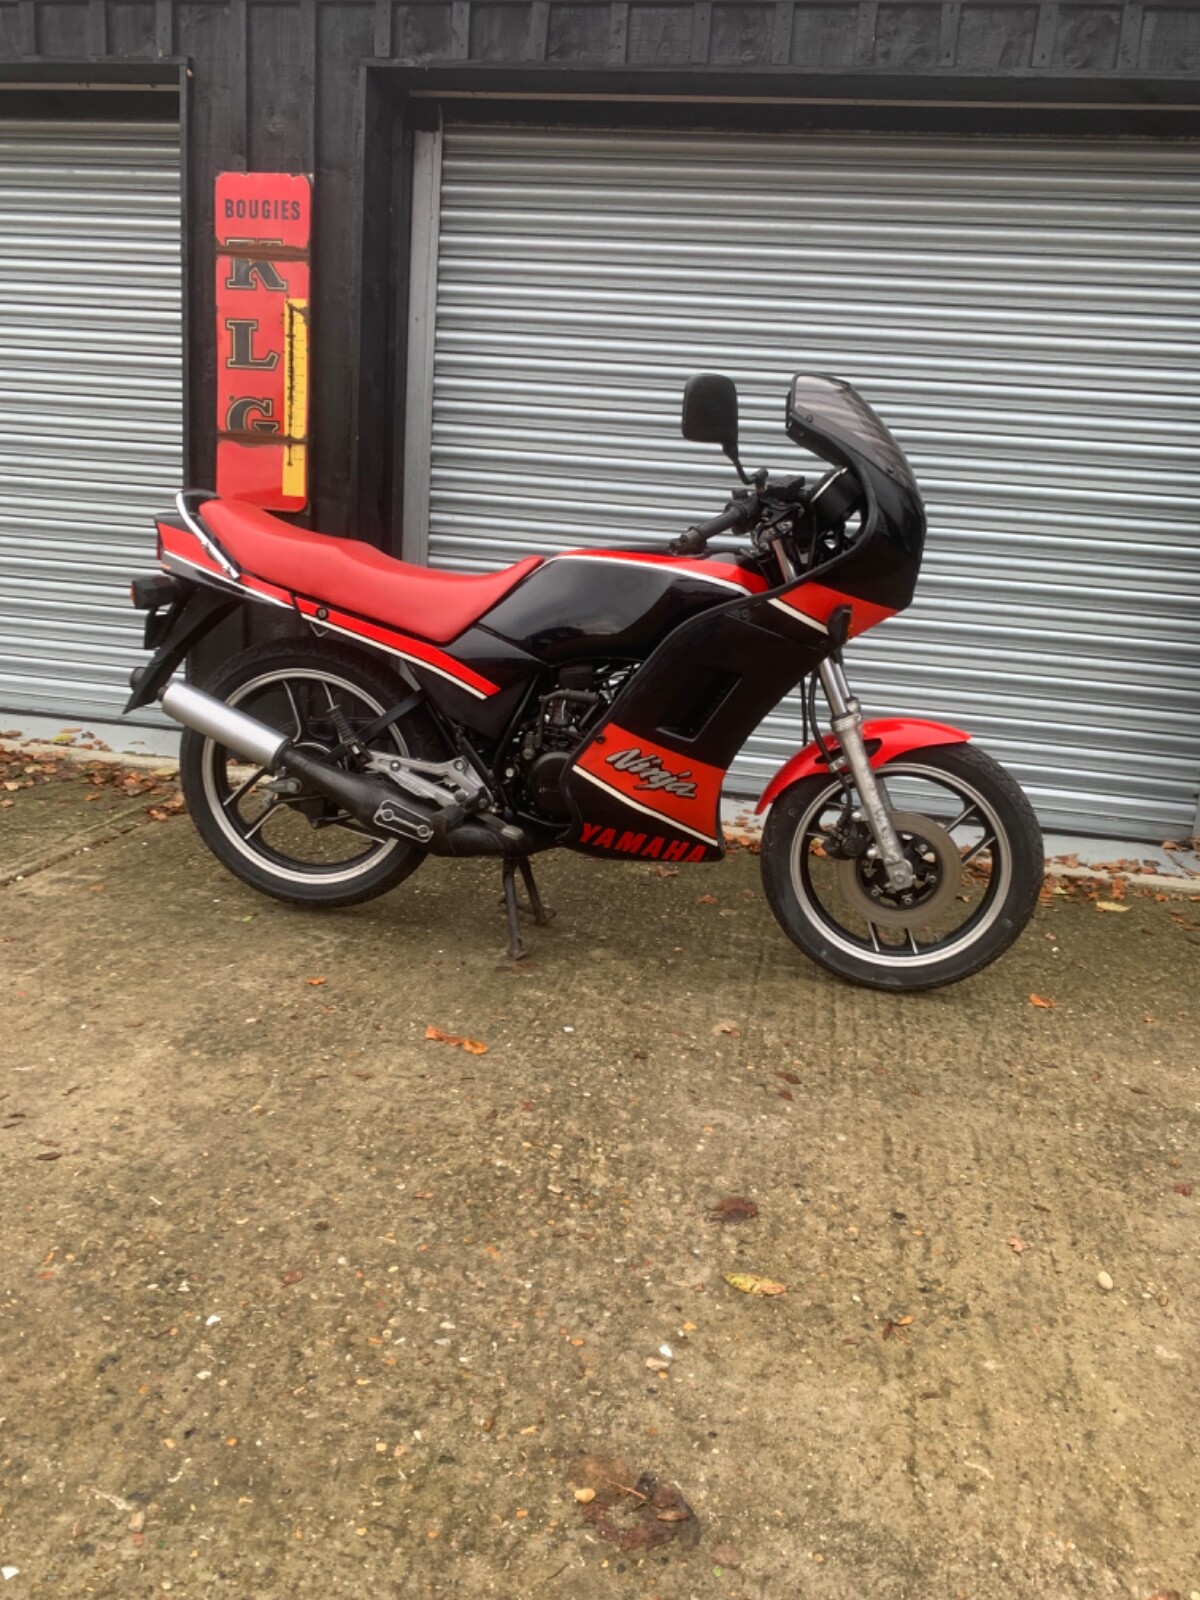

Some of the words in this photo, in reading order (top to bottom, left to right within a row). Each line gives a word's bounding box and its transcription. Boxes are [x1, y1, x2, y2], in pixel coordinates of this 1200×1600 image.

[225, 199, 300, 220] BOUGIES
[606, 748, 697, 798] Ninja
[579, 823, 707, 862] YAMAHA
